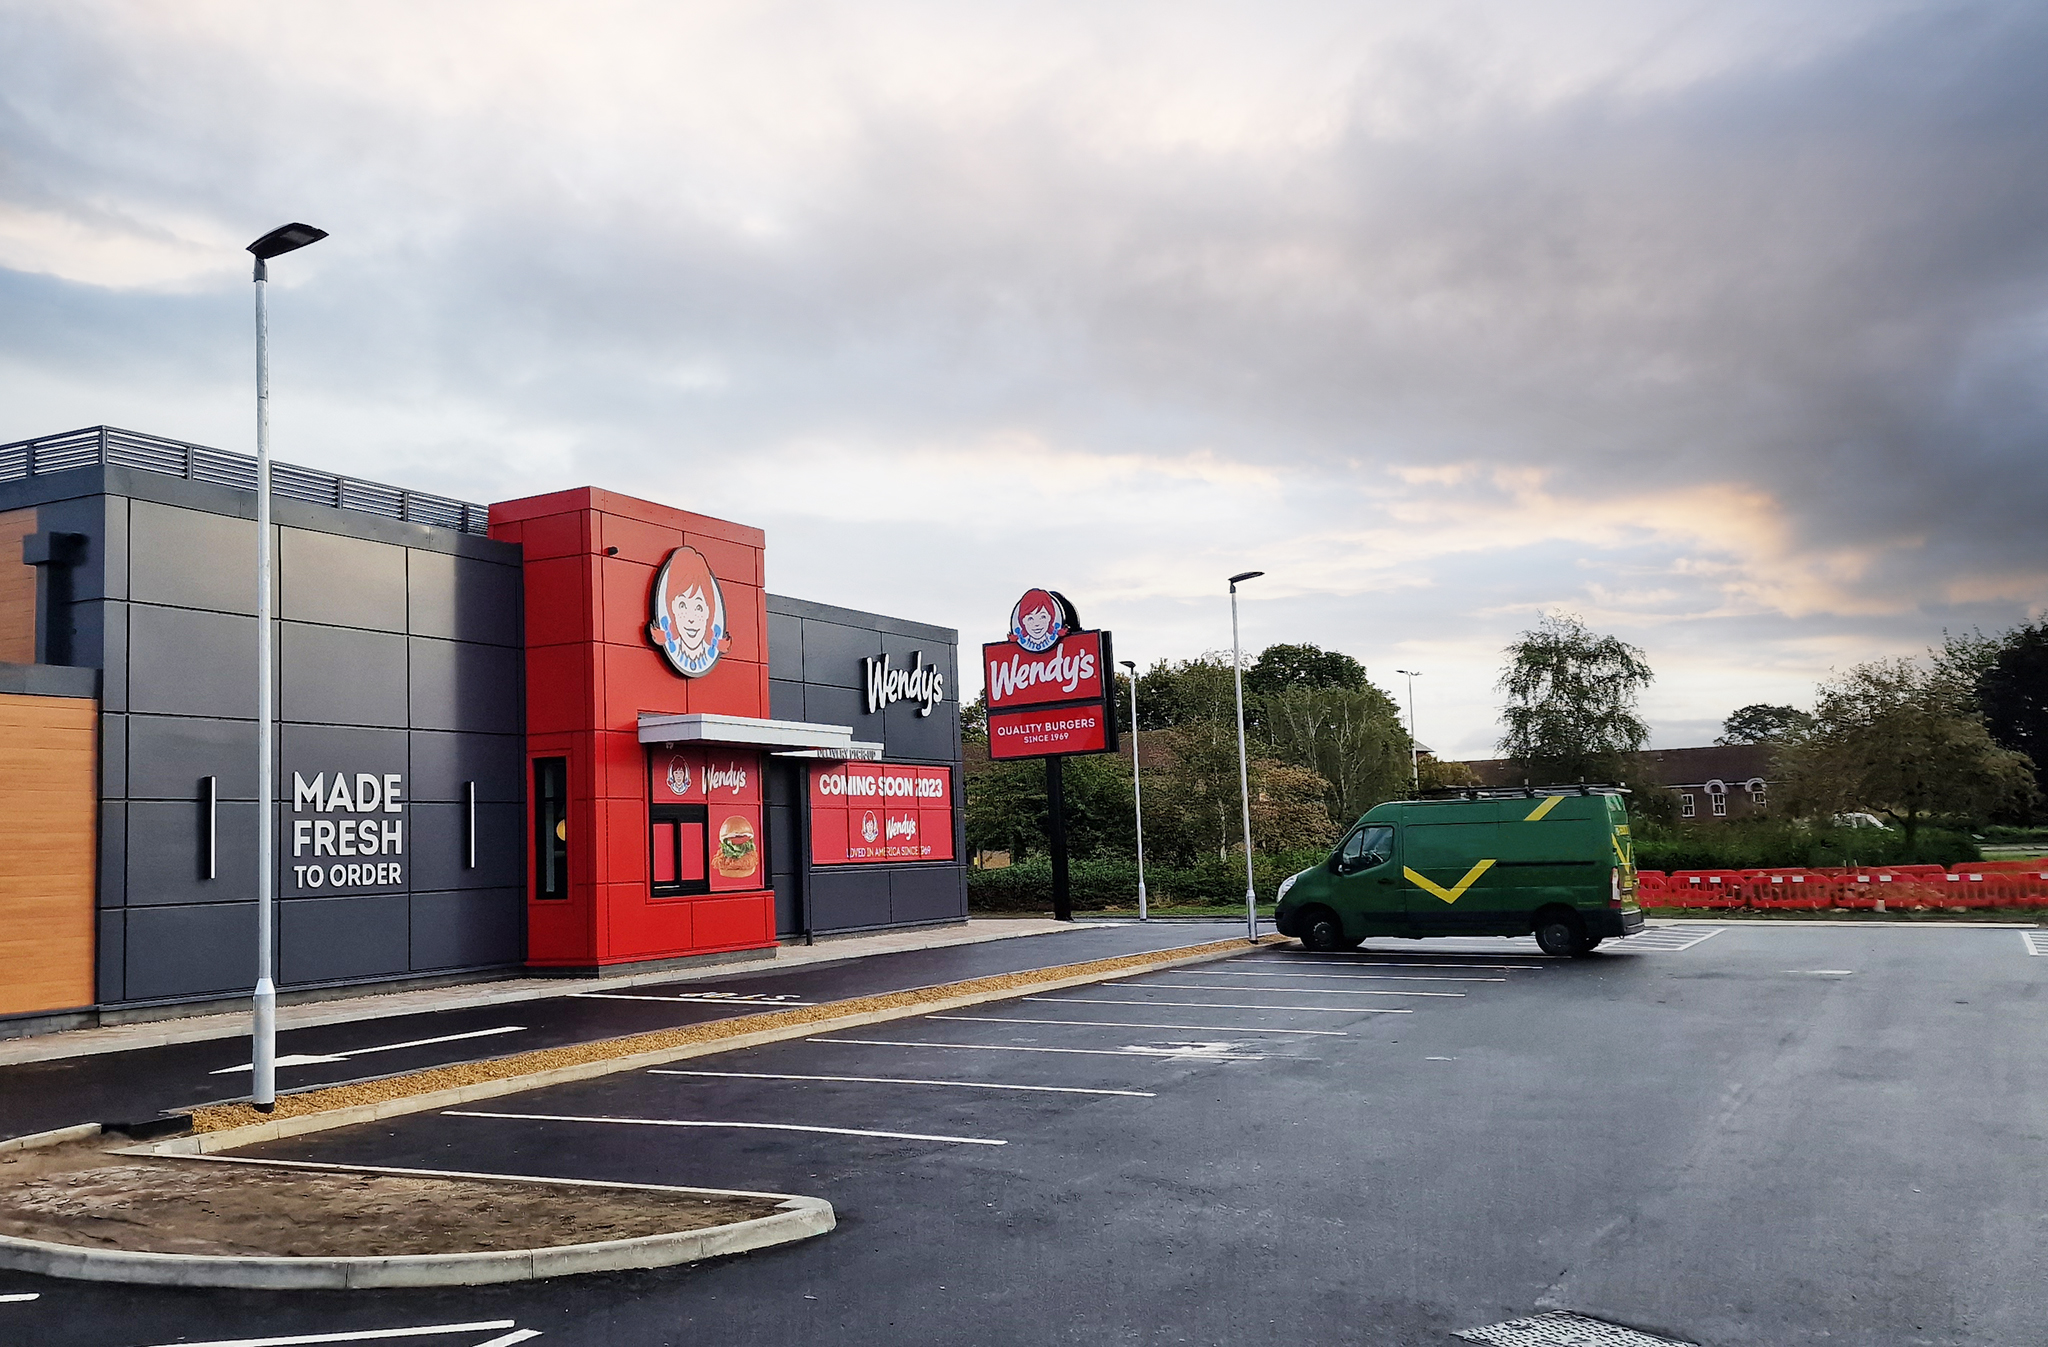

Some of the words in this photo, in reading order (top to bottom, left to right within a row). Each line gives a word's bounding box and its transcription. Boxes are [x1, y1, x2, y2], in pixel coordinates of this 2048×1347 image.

[867, 650, 943, 717] Wendy's
[990, 643, 1095, 701] Wendy's
[997, 722, 1044, 736] QUALITY
[1045, 718, 1095, 732] BURGERS
[1024, 734, 1049, 744] SINCE
[1050, 732, 1069, 742] 1969
[294, 771, 402, 813] MADE
[701, 761, 746, 795] Wendy's
[819, 774, 876, 797] COMING
[878, 776, 914, 797] SOON
[915, 778, 943, 797] 2023
[294, 819, 402, 857] FRESH
[886, 813, 916, 841] Wendy's
[875, 846, 900, 857] AMERICA
[901, 846, 918, 856] SINCE
[294, 864, 324, 888] TO
[330, 863, 402, 887] ORDER
